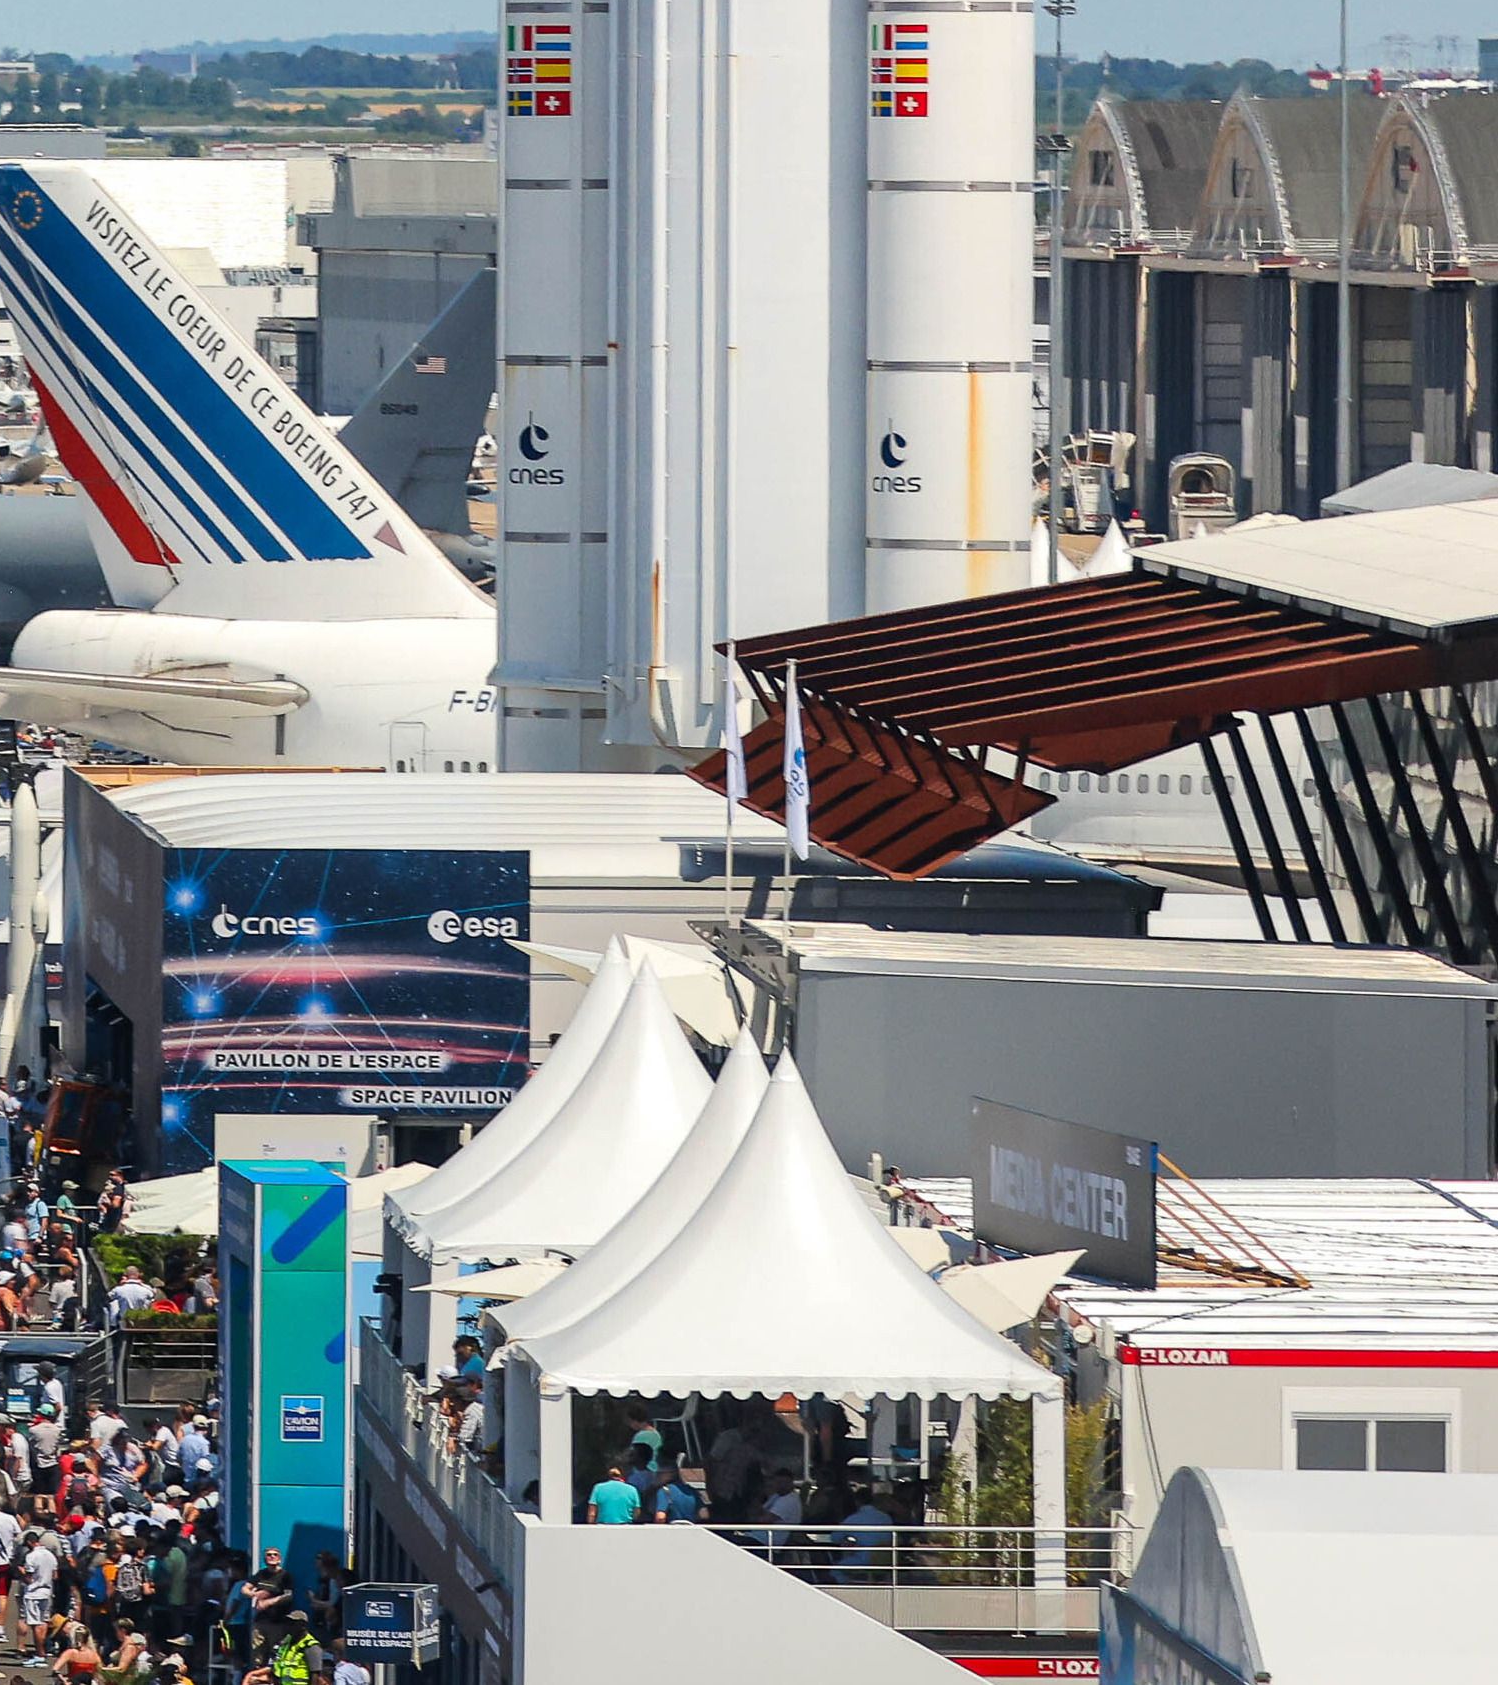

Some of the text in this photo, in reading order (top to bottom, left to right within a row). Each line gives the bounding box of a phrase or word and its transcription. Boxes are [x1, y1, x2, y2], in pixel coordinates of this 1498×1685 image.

[86, 200, 379, 521] VISITEZ LE COEUR DE CE BOEING 747
[509, 467, 564, 485] cnes
[873, 475, 922, 493] cnes
[242, 916, 317, 936] cnes
[463, 916, 519, 938] esa
[215, 1054, 441, 1069] PAVILLON DE L'ESPACE
[351, 1090, 513, 1104] SPACE PAVILION
[990, 1144, 1128, 1242] MEDIA CENTER
[1158, 1349, 1229, 1365] LOXAM
[347, 1638, 413, 1649] ET DE L'ESPACE
[378, 1631, 390, 1639] DE
